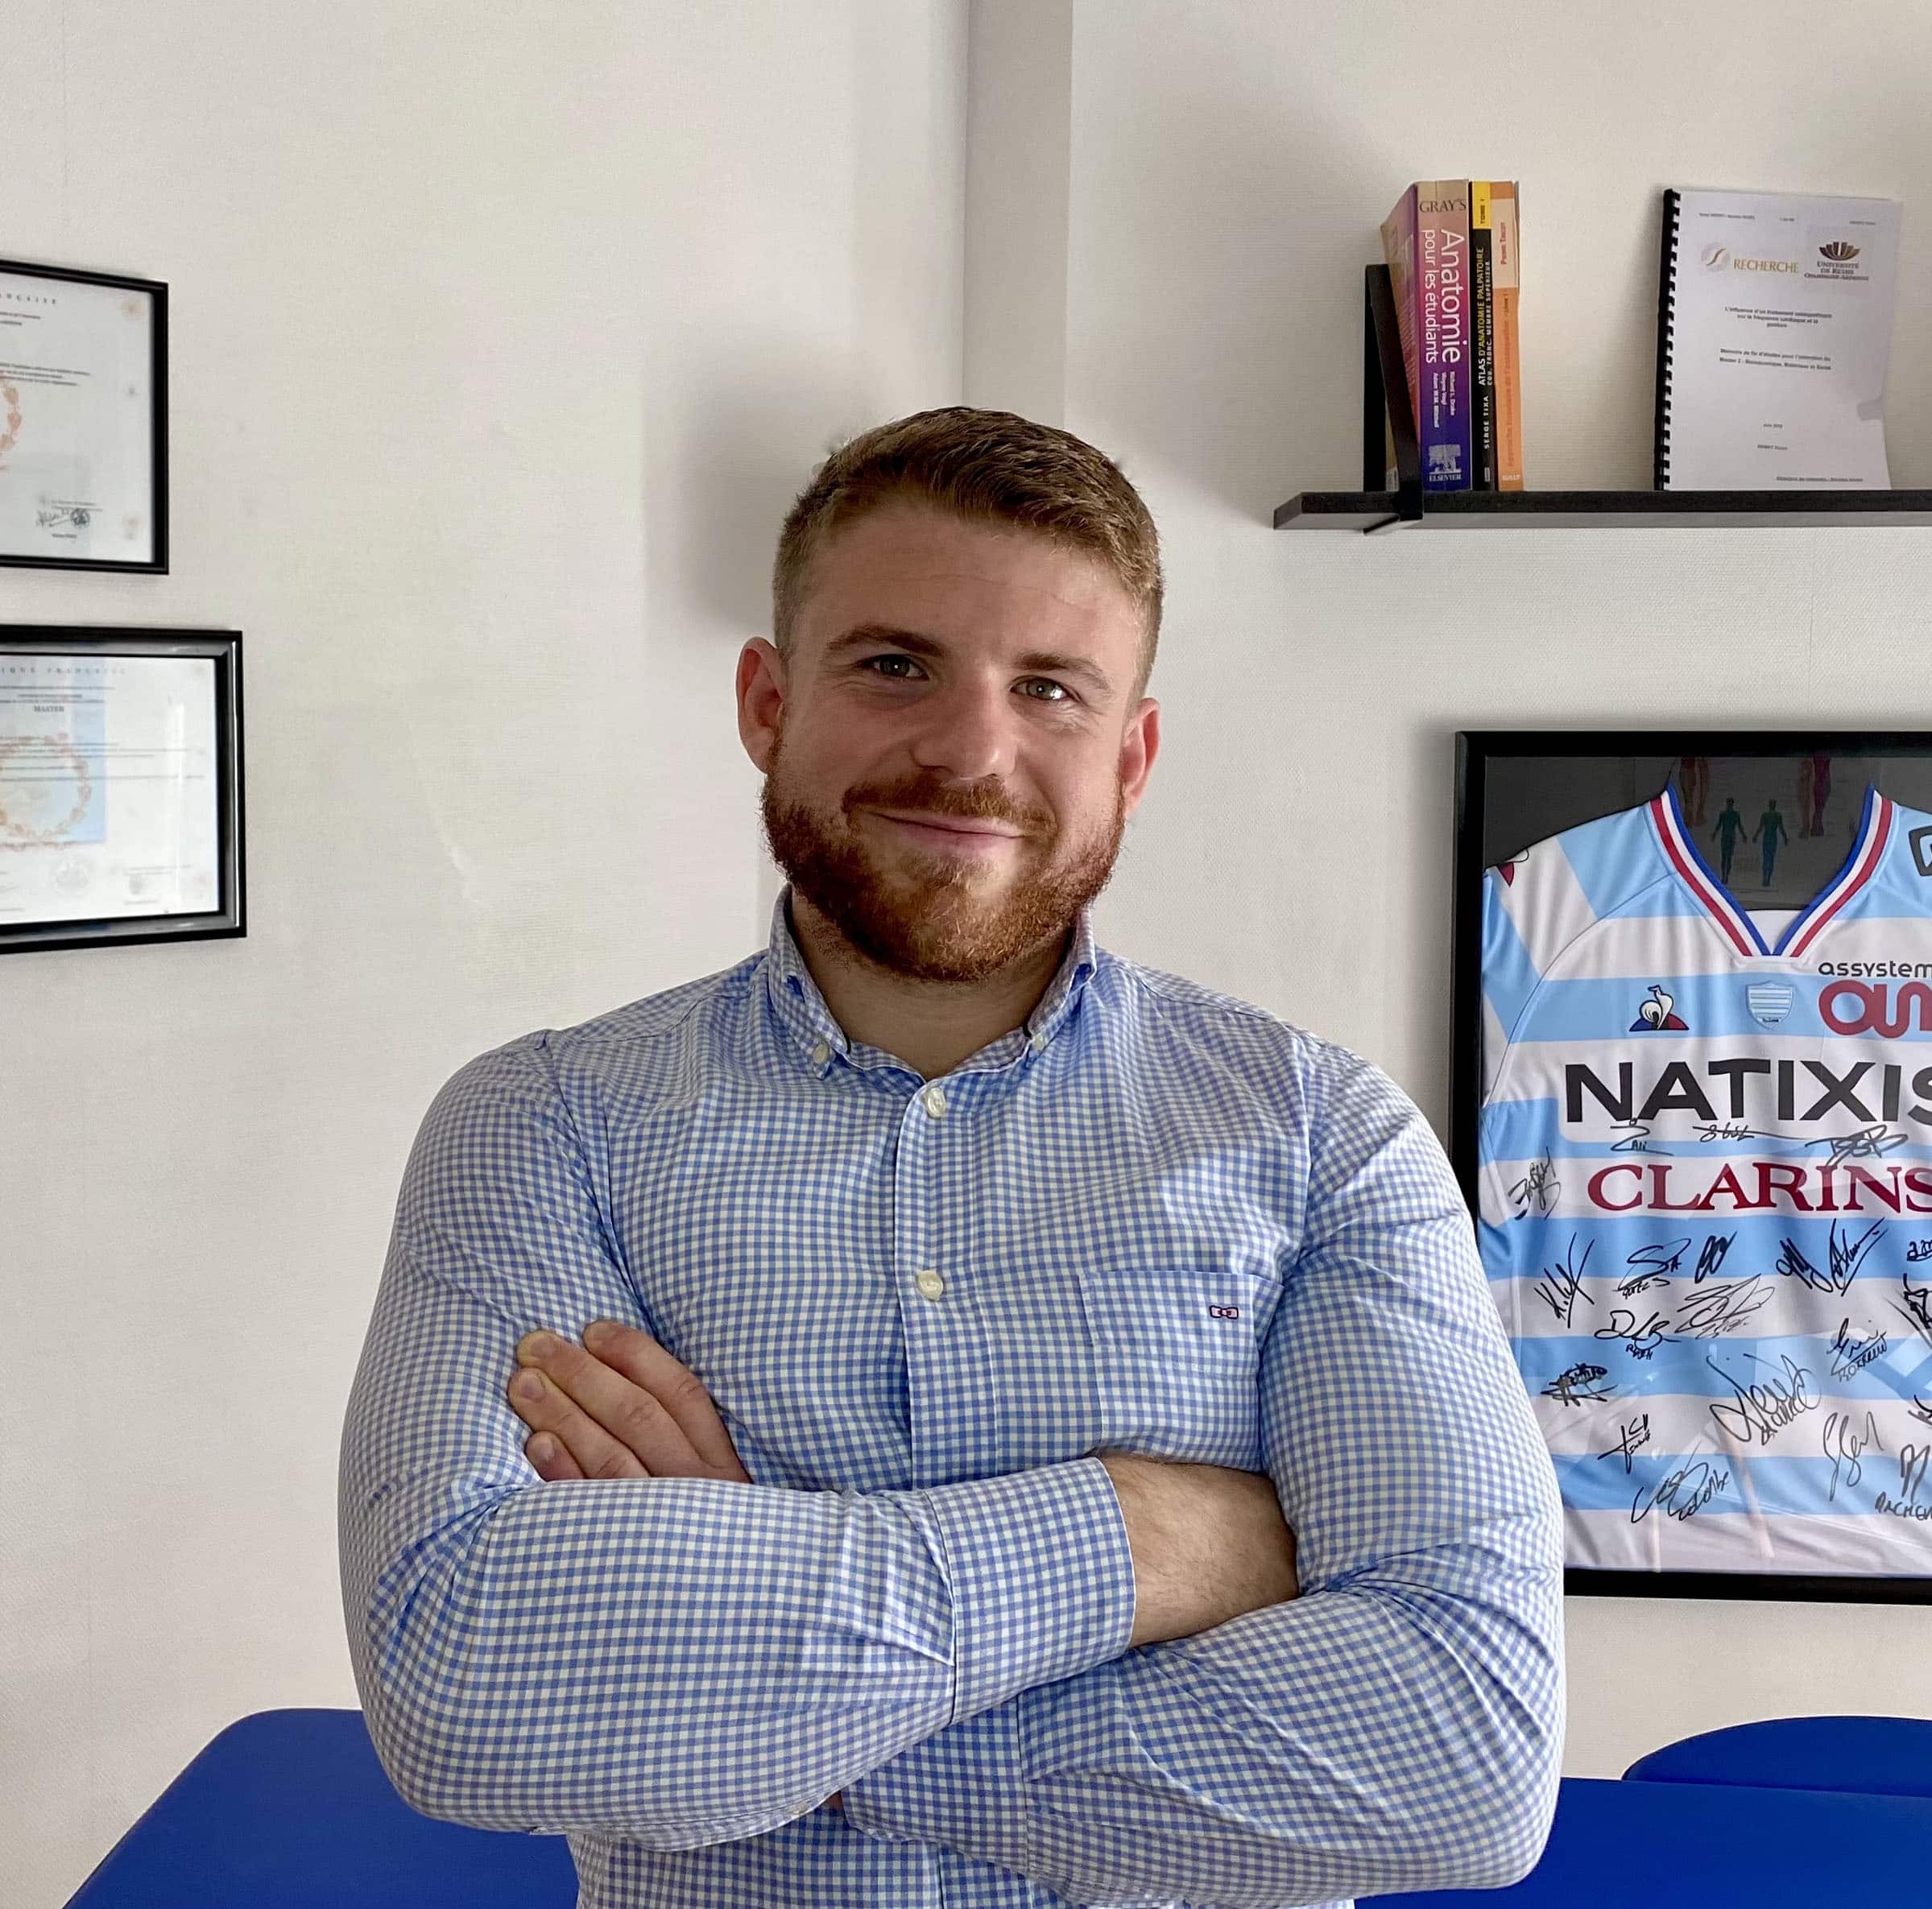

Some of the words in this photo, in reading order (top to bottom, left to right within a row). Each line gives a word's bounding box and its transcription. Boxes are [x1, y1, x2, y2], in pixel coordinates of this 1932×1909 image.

[1419, 199, 1467, 213] GRAY'S
[1421, 229, 1436, 265] pour
[1425, 268, 1439, 289] les
[1475, 247, 1484, 300] PALPATOIRE
[1441, 229, 1468, 363] Anatomie
[1425, 291, 1439, 364] étudiants
[1476, 302, 1485, 357] D'ANATOMIE
[1478, 357, 1487, 386] ATLAS
[1429, 473, 1462, 482] ELSEVIER
[1587, 1162, 1932, 1213] CLARINS
